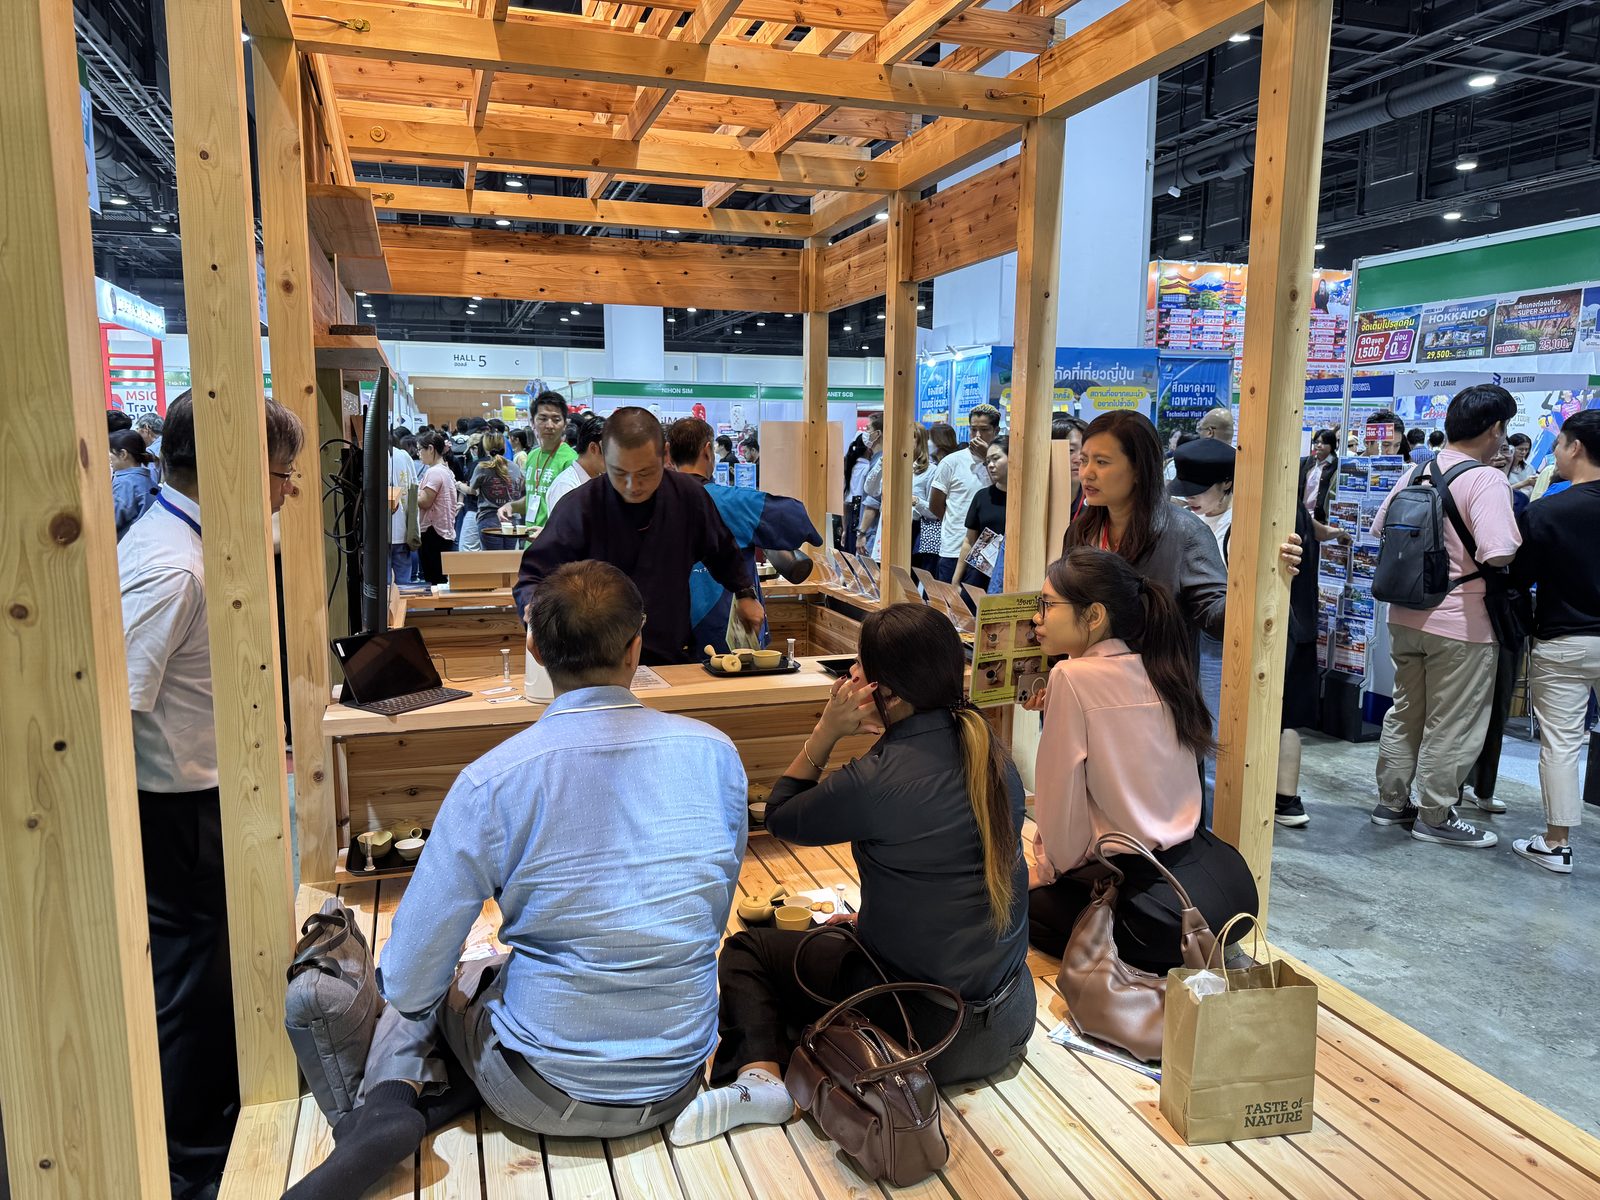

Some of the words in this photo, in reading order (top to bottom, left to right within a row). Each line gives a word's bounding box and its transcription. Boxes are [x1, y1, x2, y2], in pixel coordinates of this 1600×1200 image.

[1428, 308, 1488, 324] HOKKAIDO
[1517, 308, 1538, 316] SUPER
[1539, 305, 1556, 314] SAVE
[478, 355, 487, 368] 5
[1171, 381, 1216, 396] ศึกษาดูงาน
[1171, 396, 1213, 406] เฉพาะทาง
[1166, 410, 1190, 418] Technical
[1190, 410, 1202, 418] Visit
[1245, 1100, 1289, 1115] TASTE
[1291, 1097, 1303, 1109] of
[1244, 1109, 1303, 1128] NATURE
